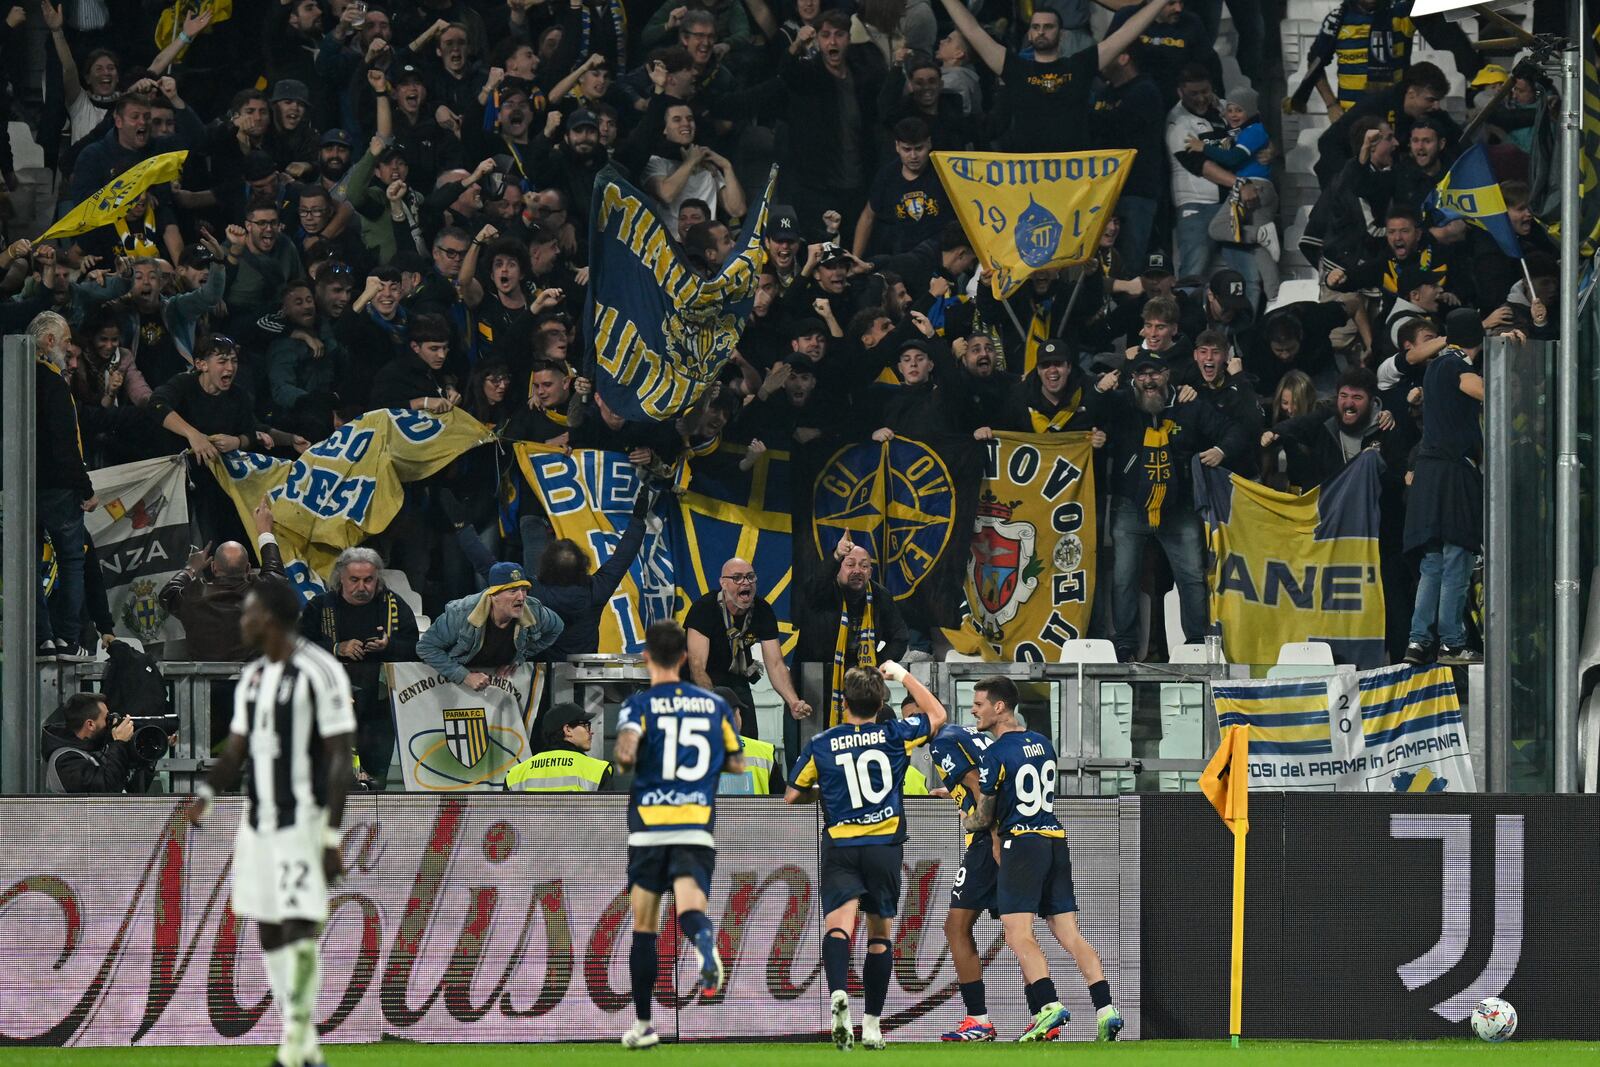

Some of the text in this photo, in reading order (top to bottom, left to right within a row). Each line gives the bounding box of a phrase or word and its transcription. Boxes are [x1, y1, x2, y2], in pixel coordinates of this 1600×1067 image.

[398, 673, 436, 704] CENTRO
[445, 710, 483, 719] PARMA F.C.
[650, 696, 716, 714] DELPRATO
[657, 715, 711, 782] 15
[830, 730, 887, 752] BERNABÉ
[1022, 743, 1046, 759] MAN
[1280, 761, 1305, 776] del
[1309, 756, 1367, 776] PARMA
[1370, 756, 1384, 769] in
[1387, 732, 1461, 764] CAMPANIA
[530, 757, 574, 770] JUVENTUS
[835, 748, 893, 810] 10
[1015, 759, 1057, 818] 98
